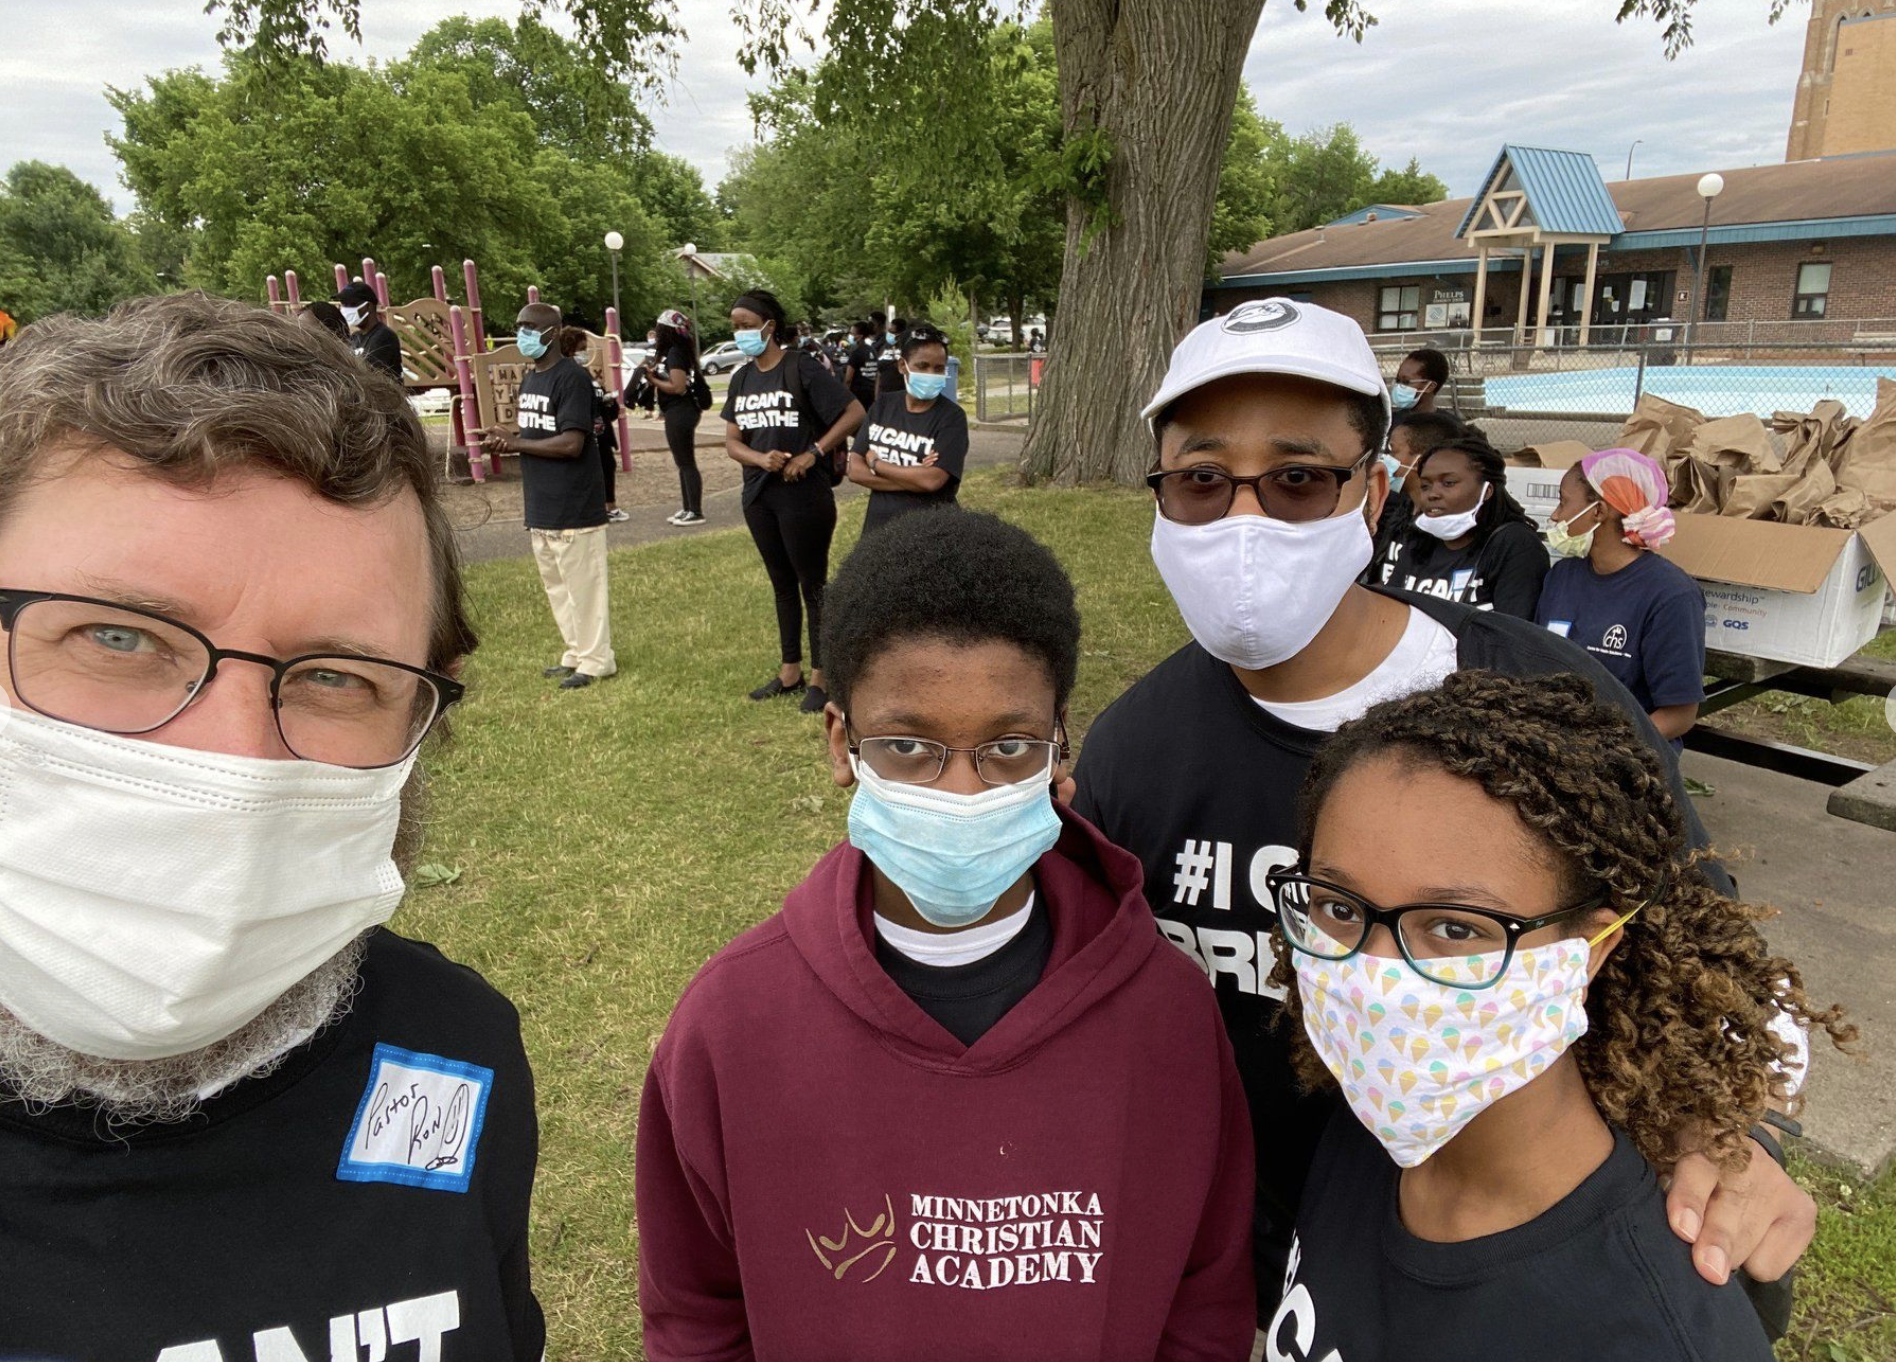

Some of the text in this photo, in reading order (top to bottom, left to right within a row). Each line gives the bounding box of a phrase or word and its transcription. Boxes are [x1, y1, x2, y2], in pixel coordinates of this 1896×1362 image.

[1703, 589, 1759, 605] ewardship
[1723, 619, 1750, 630] GQS
[1173, 839, 1233, 910] #I
[910, 1191, 1104, 1223] MINNETONKA
[909, 1219, 1104, 1256] CHRISTIAN
[909, 1250, 1104, 1290] ACADEMY
